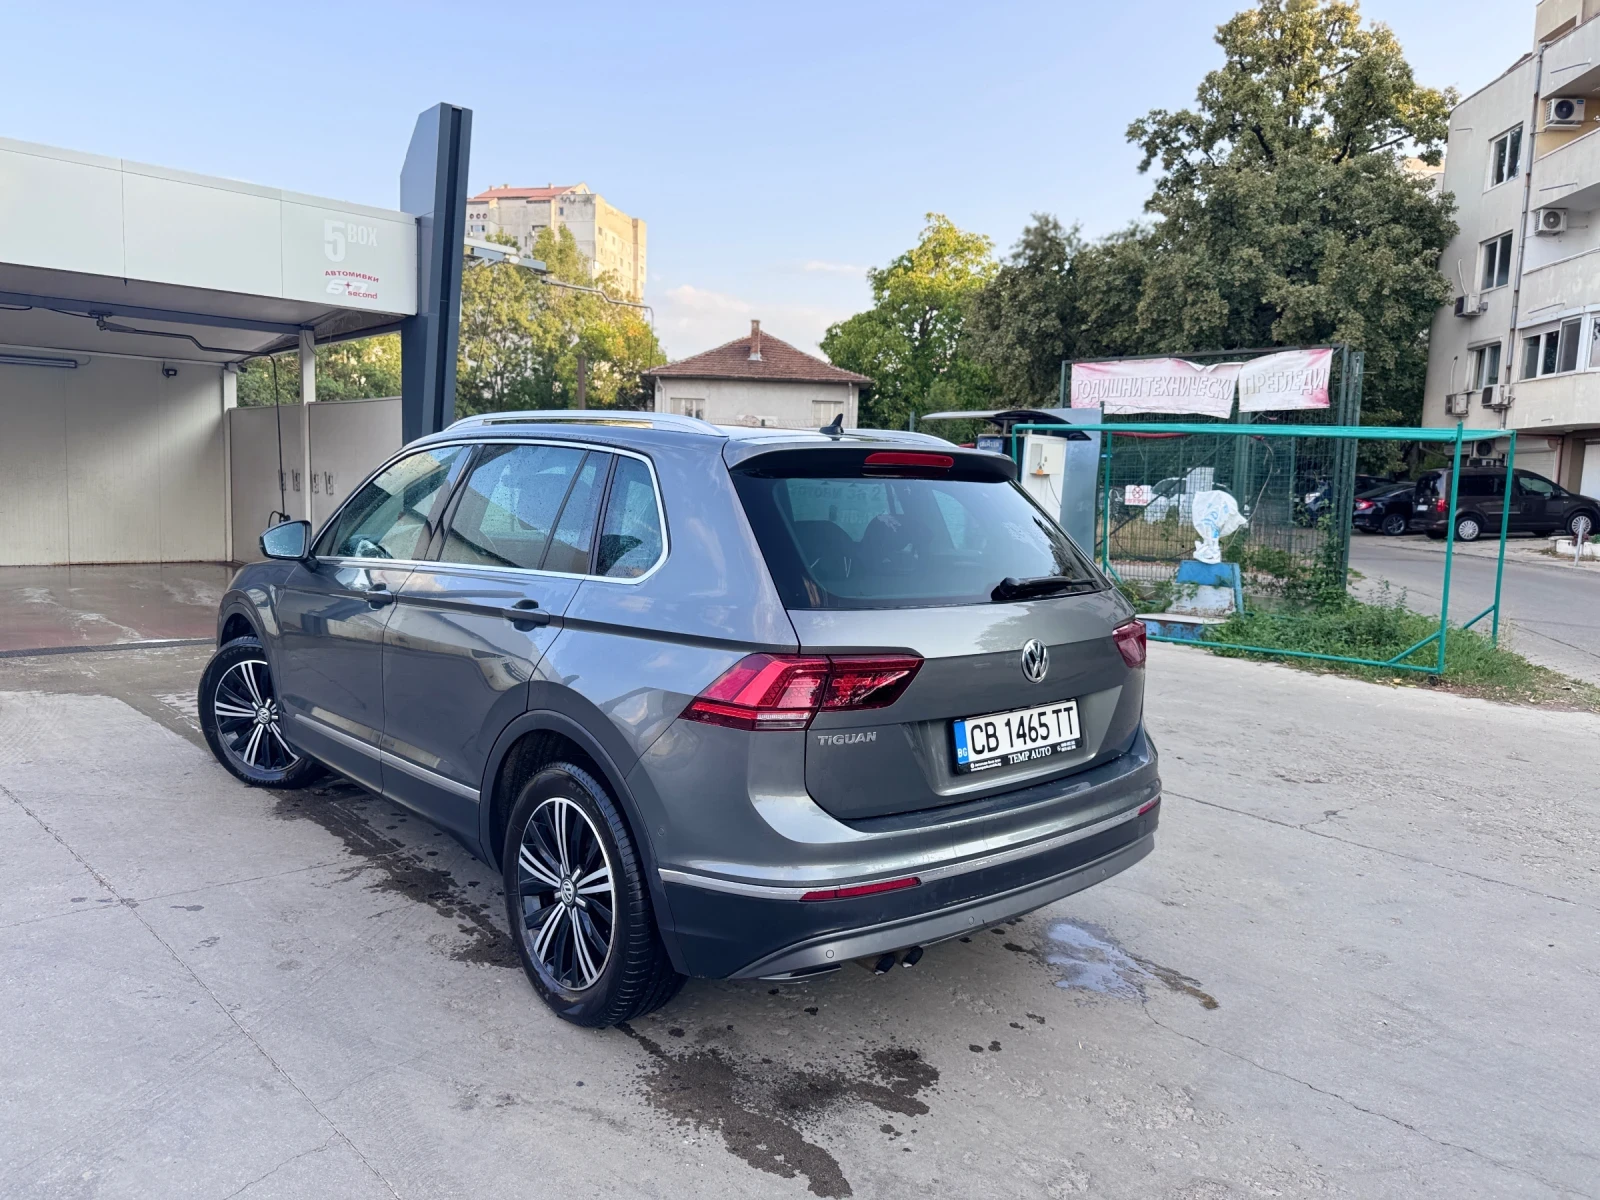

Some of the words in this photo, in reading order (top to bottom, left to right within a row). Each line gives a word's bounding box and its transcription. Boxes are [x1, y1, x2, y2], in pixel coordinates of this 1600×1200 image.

[324, 220, 345, 262] 5
[348, 223, 378, 246] BOX
[325, 270, 379, 282] АВТОМИВКИ
[347, 290, 378, 299] second
[1075, 377, 1144, 403] ГОДИШНИ
[1243, 368, 1326, 396] ПРЕГЛЕДИ
[971, 721, 1000, 755] CB
[1005, 711, 1050, 748] 1465
[1052, 706, 1074, 737] TT
[957, 747, 968, 758] BG
[1008, 751, 1030, 764] TEMP
[1030, 746, 1052, 760] AUTO
